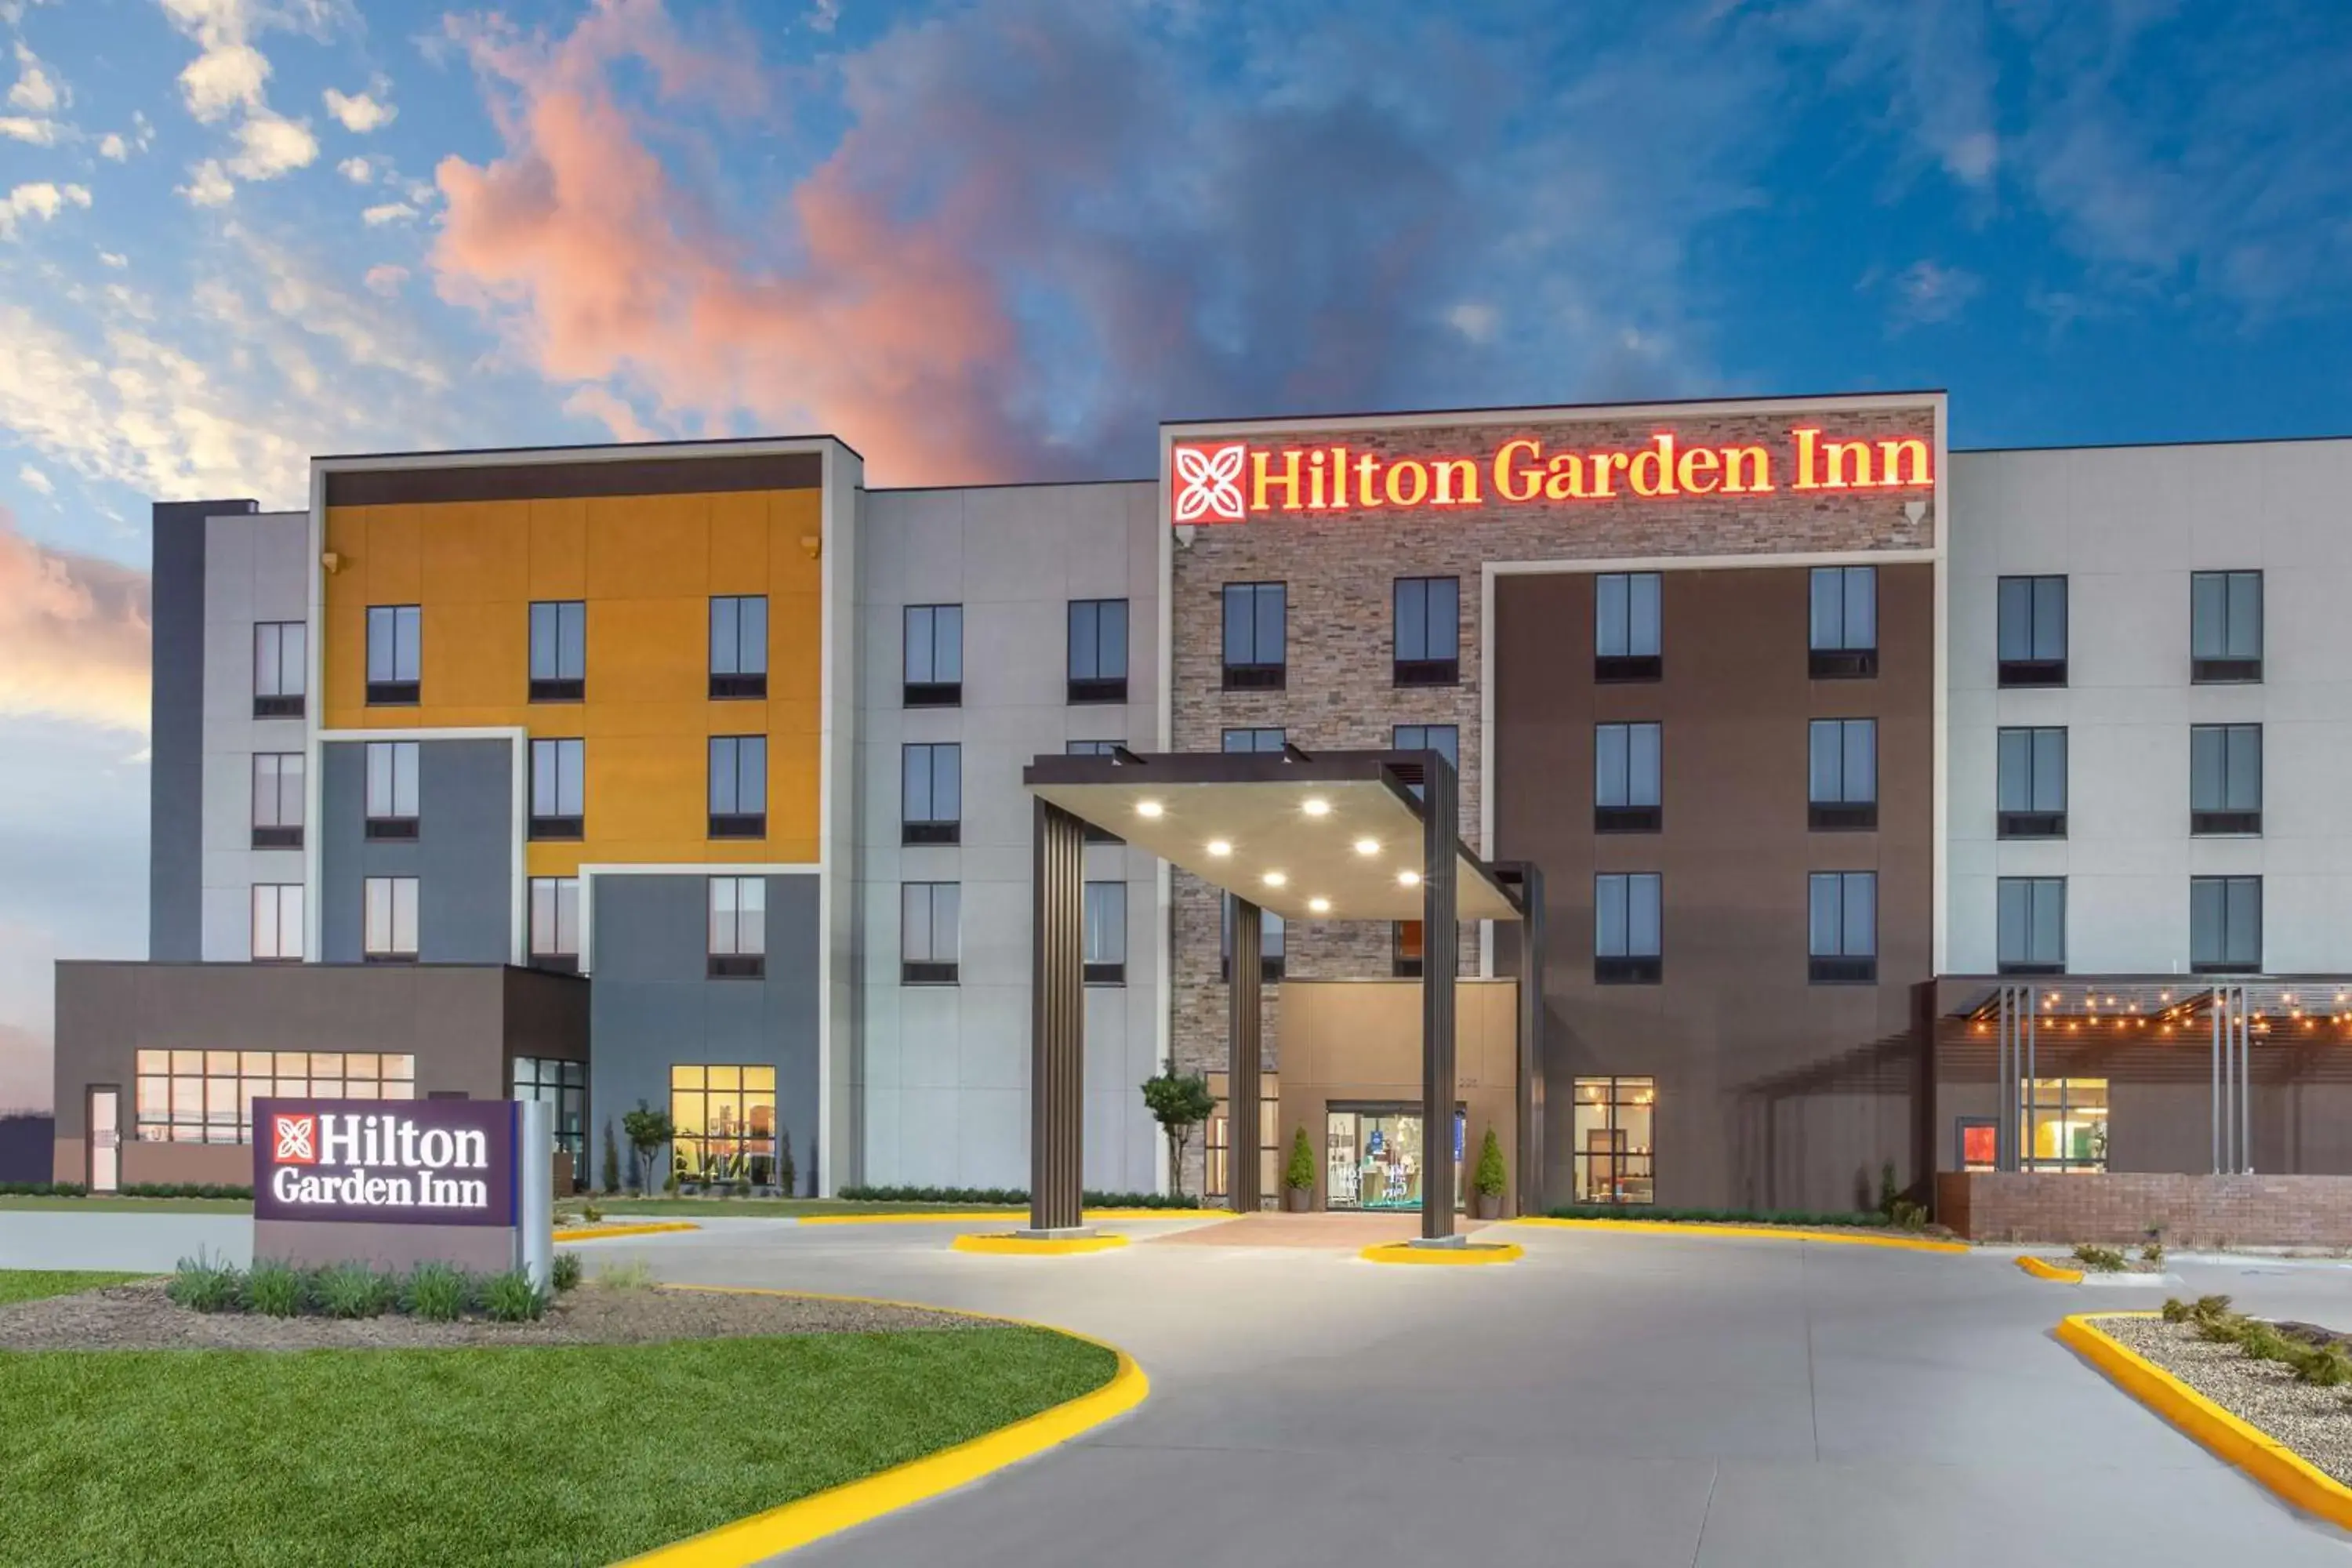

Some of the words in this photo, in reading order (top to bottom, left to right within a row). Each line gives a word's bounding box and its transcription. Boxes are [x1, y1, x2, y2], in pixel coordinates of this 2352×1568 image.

[1250, 448, 1482, 511] Hilton
[1494, 434, 1775, 502] Garden
[1791, 428, 1933, 493] Inn
[318, 1115, 488, 1168] Hilton
[273, 1166, 414, 1206] Garden
[418, 1171, 488, 1207] Inn
